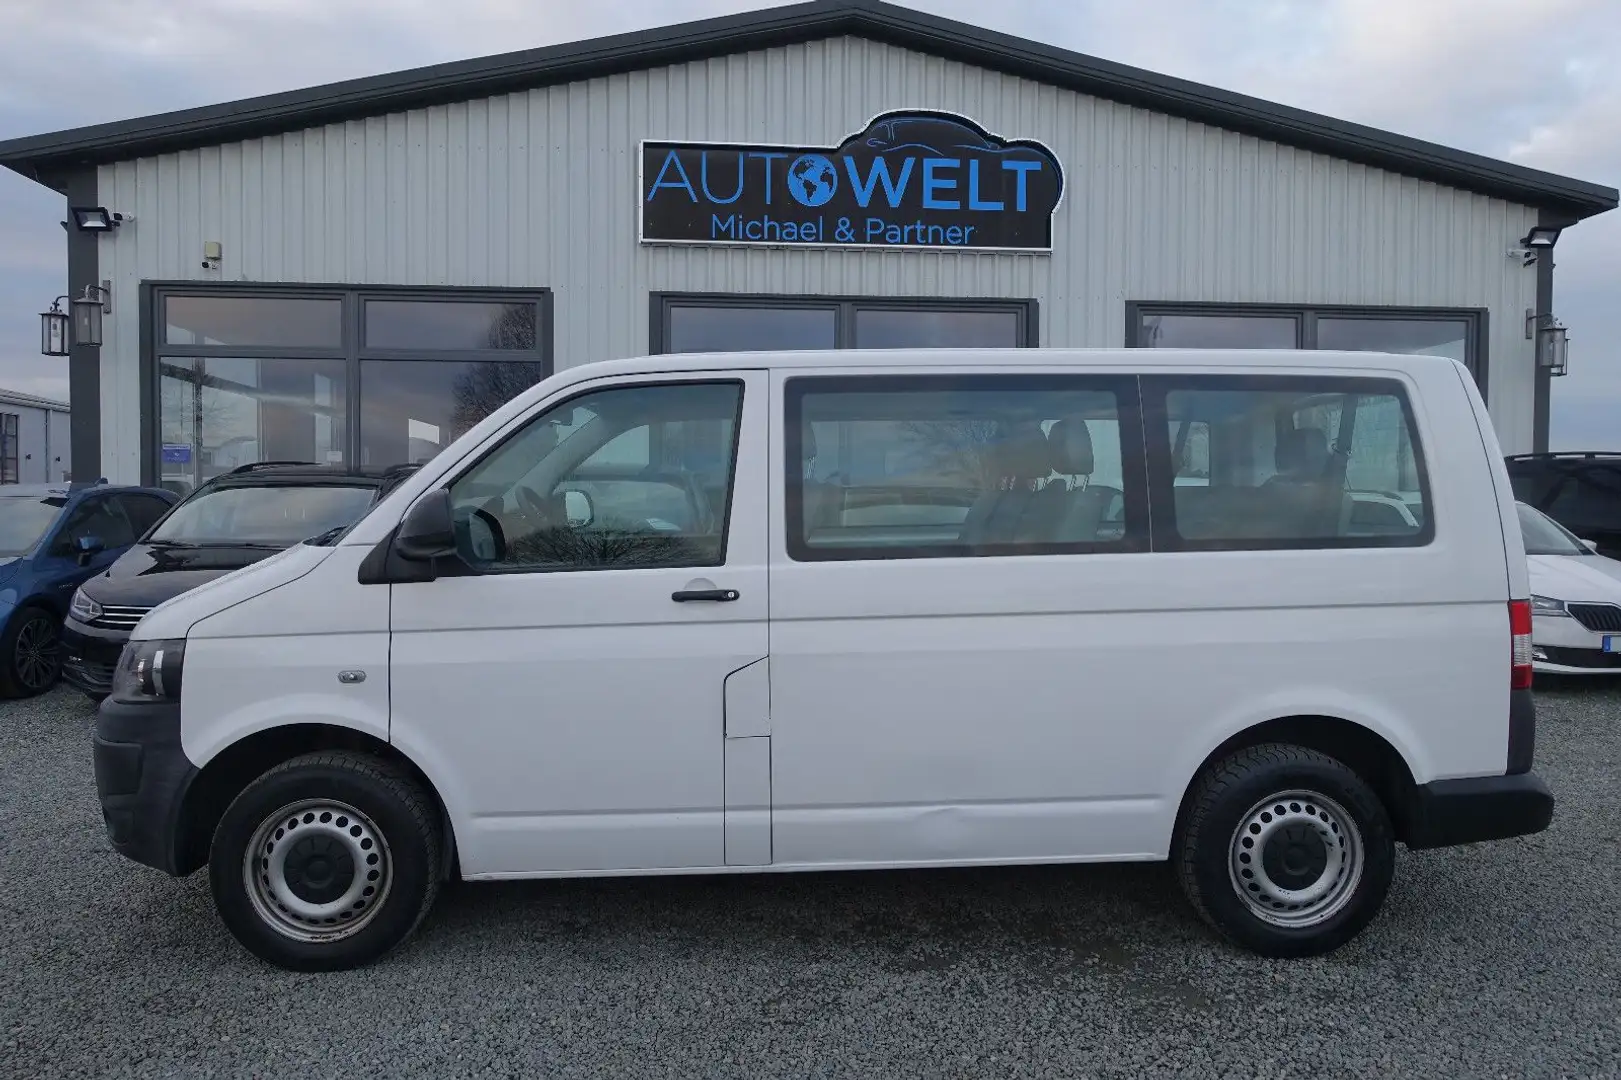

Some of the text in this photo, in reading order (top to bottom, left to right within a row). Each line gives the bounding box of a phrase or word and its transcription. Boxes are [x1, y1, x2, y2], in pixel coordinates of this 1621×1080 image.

[711, 213, 976, 245] Michael & Partner
